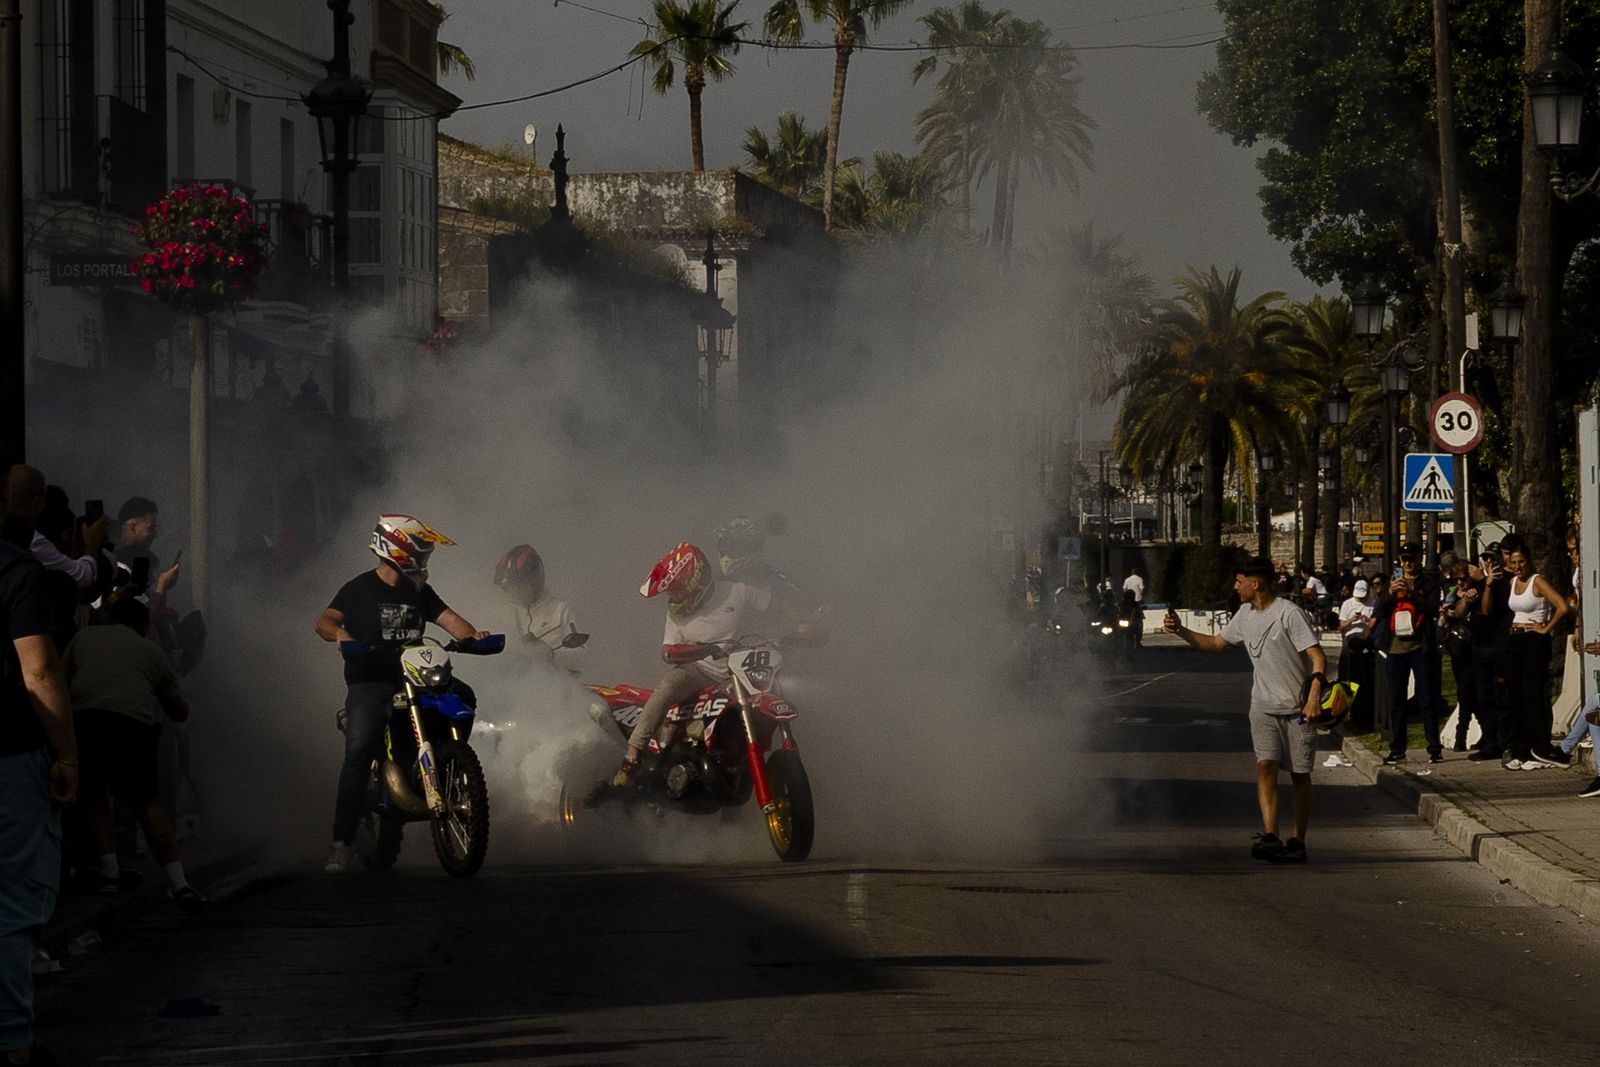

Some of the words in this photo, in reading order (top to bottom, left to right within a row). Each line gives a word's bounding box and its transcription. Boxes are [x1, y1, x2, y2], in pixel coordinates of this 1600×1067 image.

[56, 264, 80, 277] LOS
[83, 264, 138, 277] PORTAL
[1440, 411, 1472, 431] 30
[741, 651, 771, 669] 48
